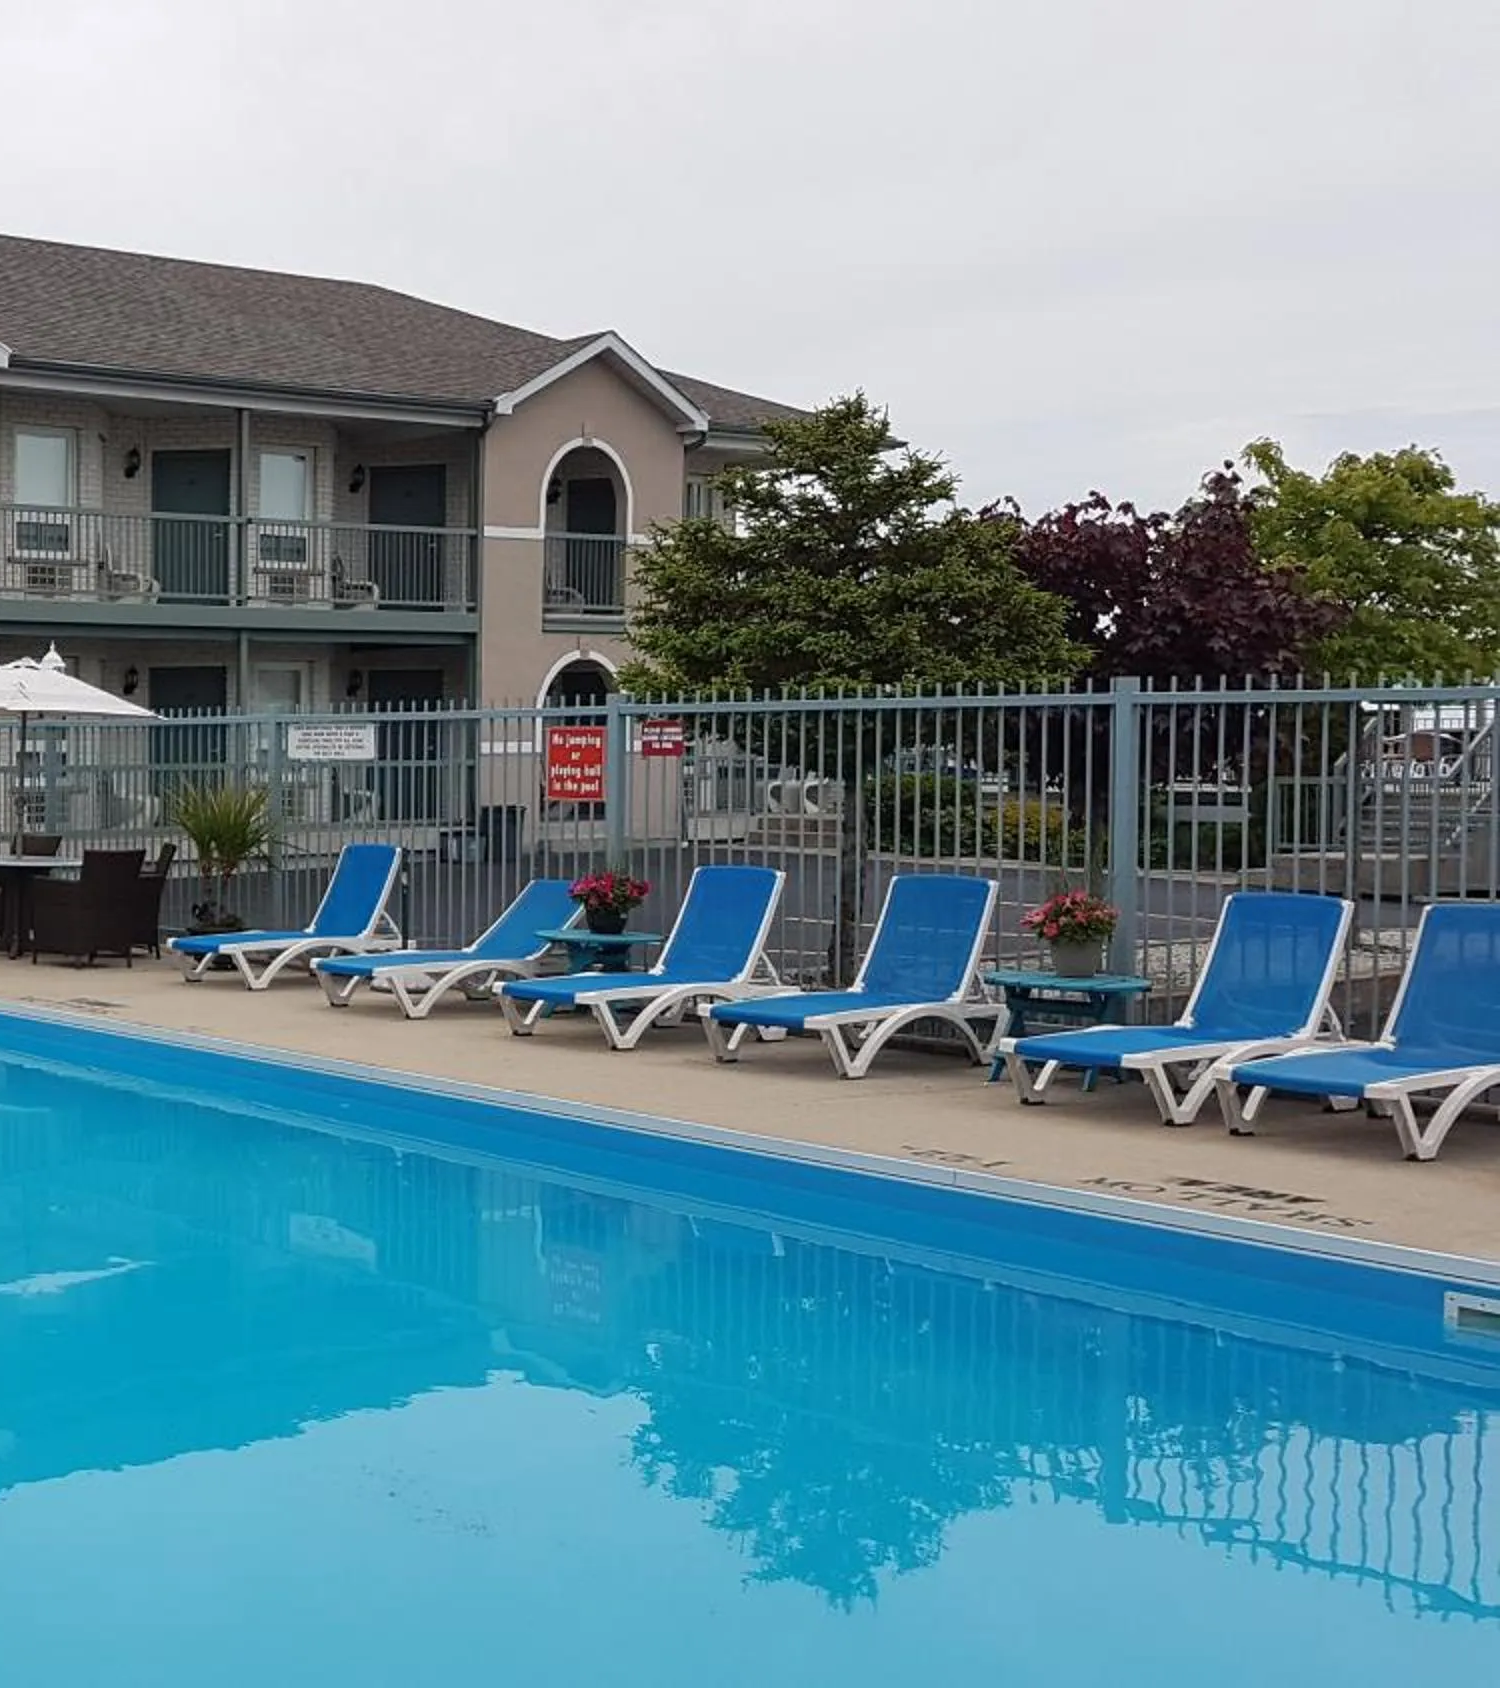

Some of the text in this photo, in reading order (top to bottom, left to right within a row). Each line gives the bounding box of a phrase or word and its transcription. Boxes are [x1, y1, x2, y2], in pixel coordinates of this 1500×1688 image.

[552, 733, 601, 749] No jumping
[551, 764, 600, 778] playing ball
[564, 780, 578, 791] the
[581, 780, 599, 794] pool
